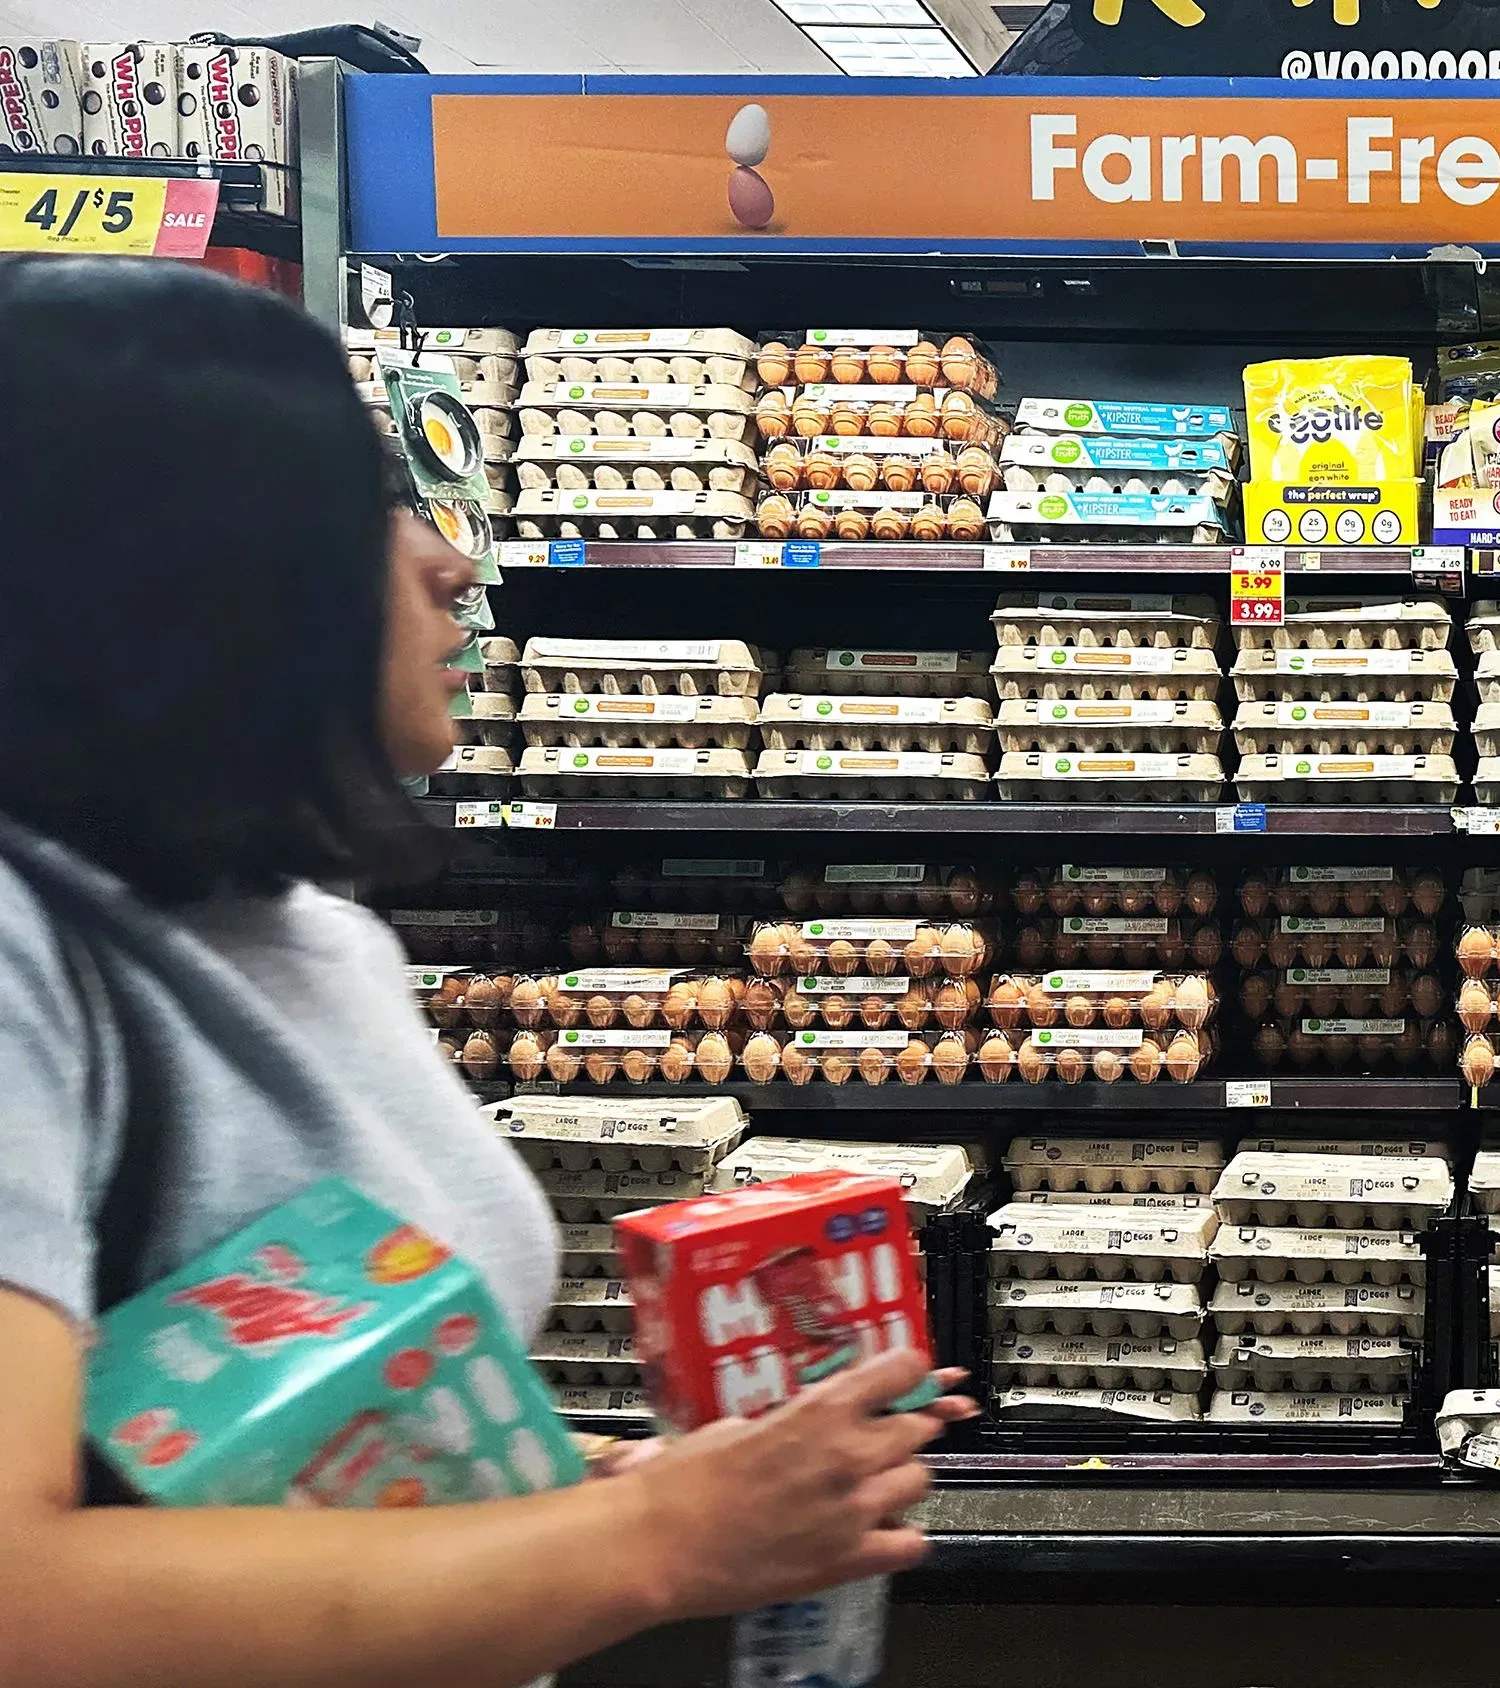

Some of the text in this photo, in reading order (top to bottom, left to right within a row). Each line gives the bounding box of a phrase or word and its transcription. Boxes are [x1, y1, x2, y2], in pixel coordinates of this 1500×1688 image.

[164, 213, 205, 227] SALE
[1435, 426, 1444, 435] TO
[1312, 462, 1345, 471] original
[1287, 490, 1376, 503] the perfect wrap
[1450, 499, 1473, 510] READY
[1450, 511, 1477, 521] TO EAT!
[1272, 518, 1282, 527] 5g
[1308, 518, 1319, 526] 25
[1345, 519, 1356, 528] 0g
[1381, 519, 1392, 529] 0g
[528, 555, 545, 564] 9.29
[1010, 560, 1027, 568] 8.99
[1241, 577, 1272, 588] 5.99
[1240, 603, 1275, 619] 3.99
[1252, 1095, 1268, 1104] 19.79
